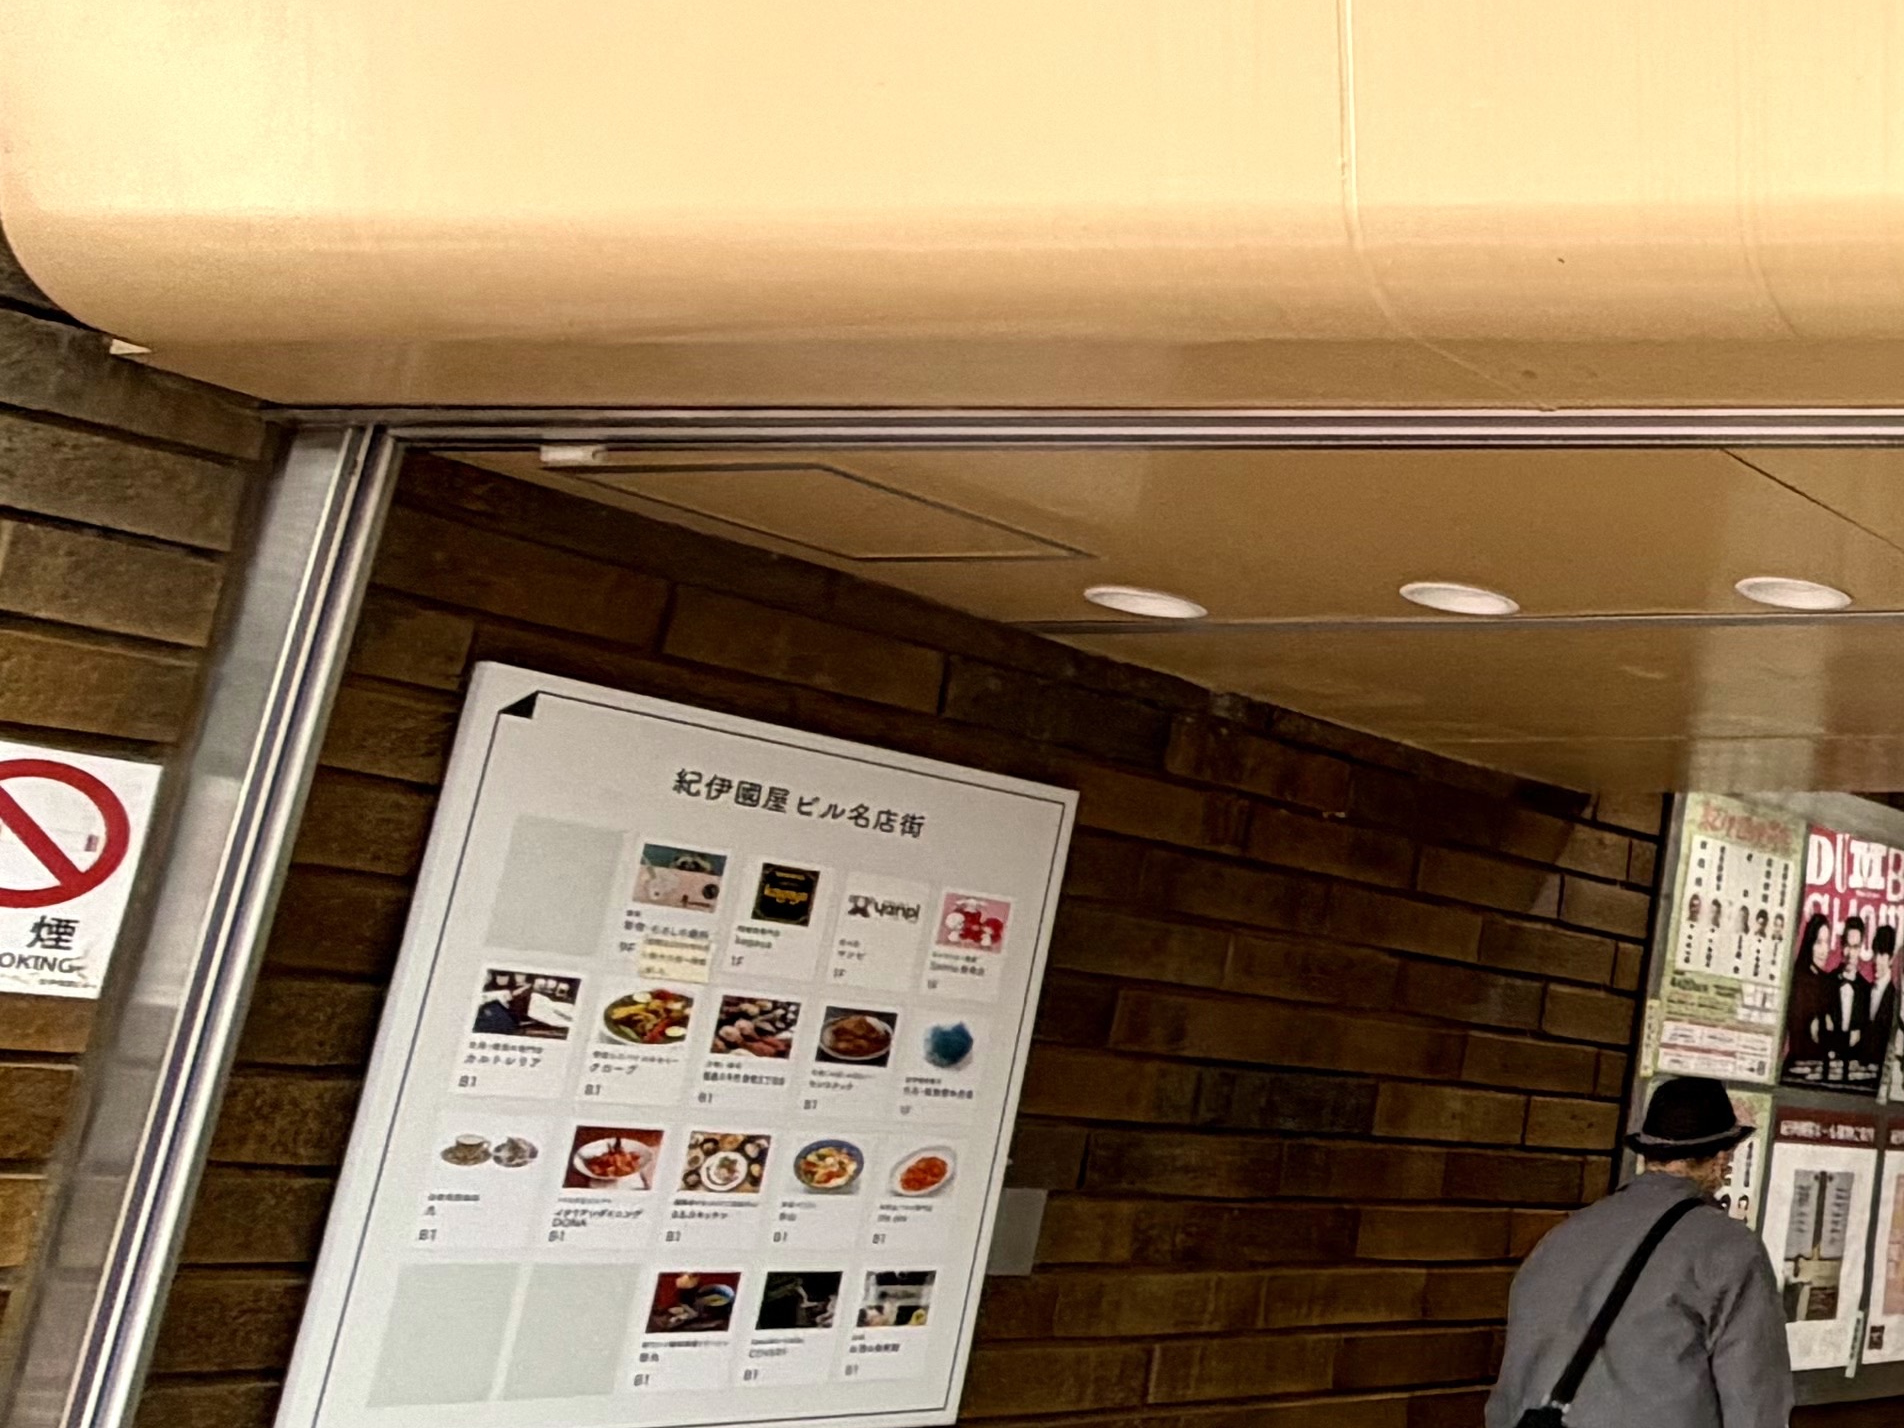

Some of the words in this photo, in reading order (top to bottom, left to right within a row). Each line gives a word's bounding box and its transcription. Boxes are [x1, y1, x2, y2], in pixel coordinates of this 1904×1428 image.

[672, 768, 926, 839] 紀伊國屋ビル名店街
[26, 914, 80, 951] 煙
[457, 1075, 477, 1088] B1
[584, 1083, 601, 1096] B1
[697, 1091, 714, 1104] B1
[417, 1228, 438, 1241] B1
